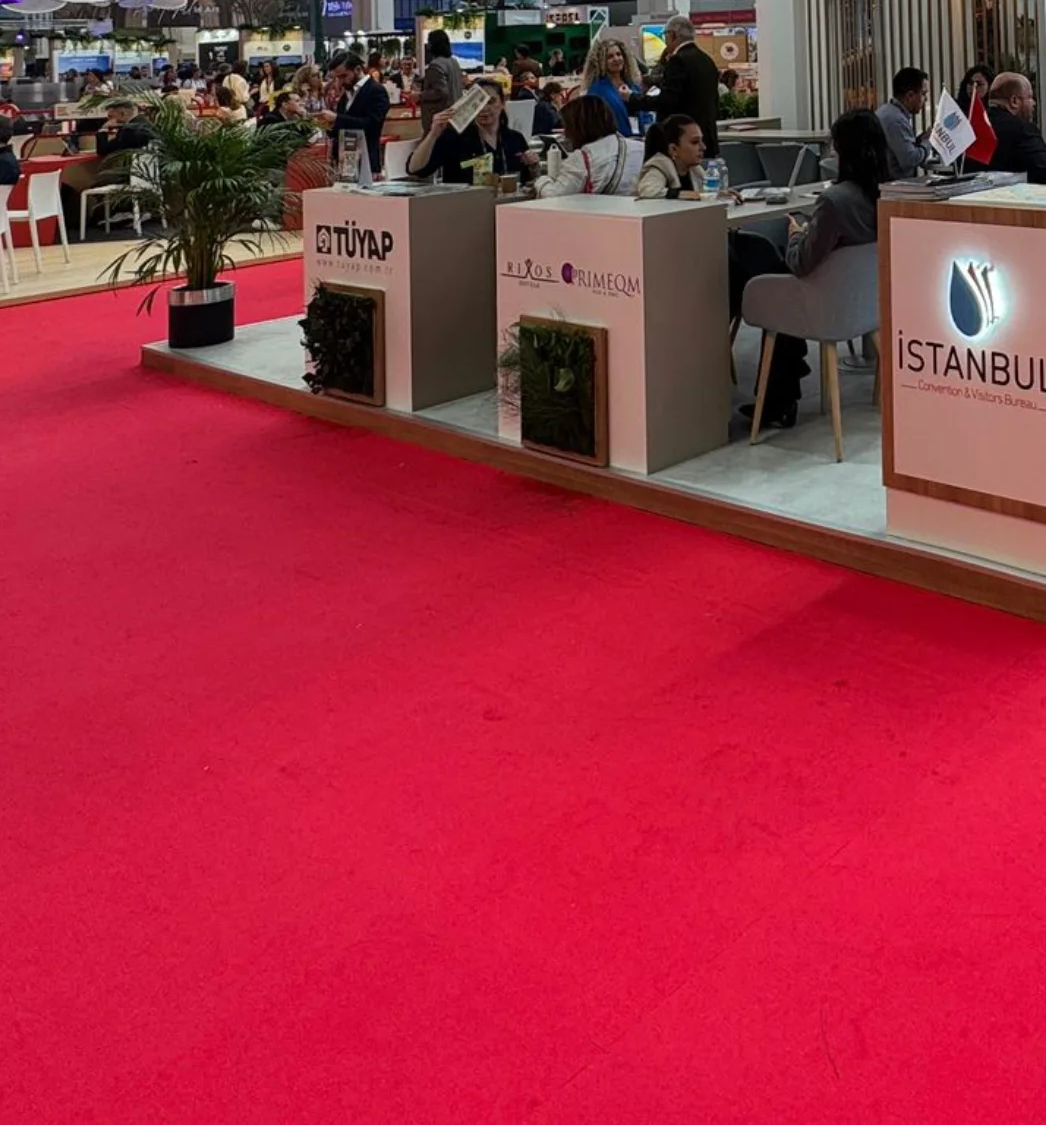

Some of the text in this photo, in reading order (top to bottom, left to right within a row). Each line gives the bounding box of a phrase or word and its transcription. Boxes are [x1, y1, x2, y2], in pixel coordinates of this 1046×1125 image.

[332, 220, 393, 262] TÜYAP
[507, 258, 552, 278] RIXOS
[918, 379, 1037, 410] Convention & Visitors Bureau
